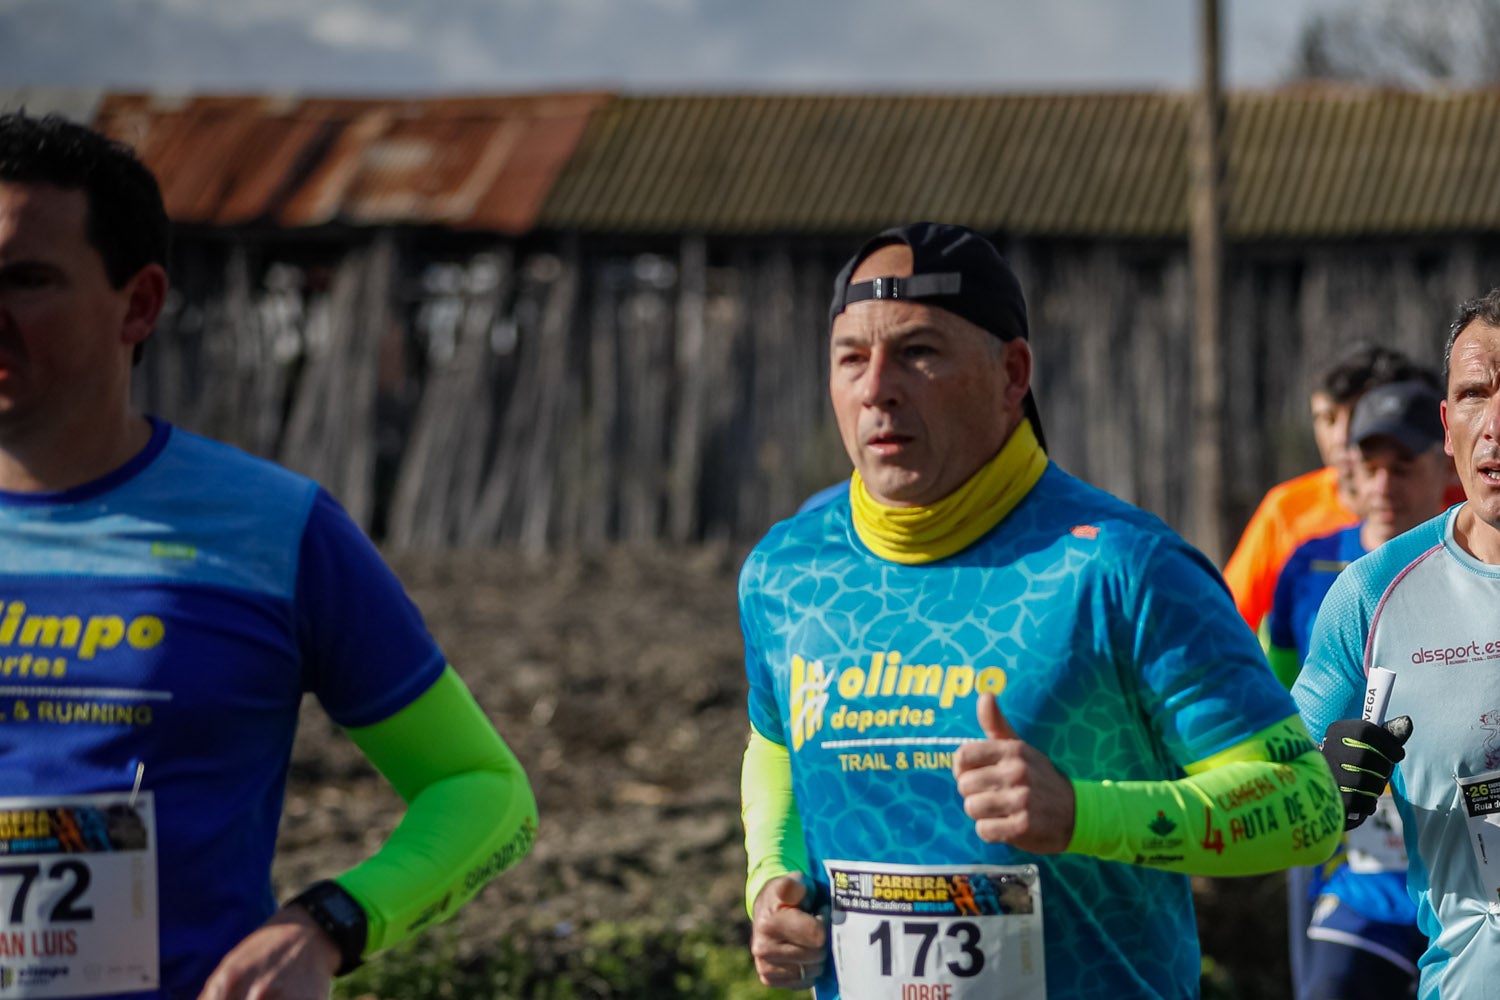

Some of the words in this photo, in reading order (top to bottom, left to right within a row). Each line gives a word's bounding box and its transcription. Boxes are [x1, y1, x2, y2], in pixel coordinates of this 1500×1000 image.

[0, 601, 165, 659] impo
[838, 650, 1007, 708] olimpo
[38, 702, 153, 725] RUNNING
[1364, 687, 1377, 721] VEGA
[831, 705, 935, 733] deportes
[838, 753, 891, 772] TRAIL
[896, 752, 909, 770] &
[914, 751, 956, 770] RUN
[1469, 784, 1489, 798] 26
[1202, 806, 1225, 854] 4
[873, 874, 948, 889] CARRERA
[873, 888, 949, 901] POPULAR
[32, 928, 78, 957] LUIS
[869, 920, 985, 978] 173
